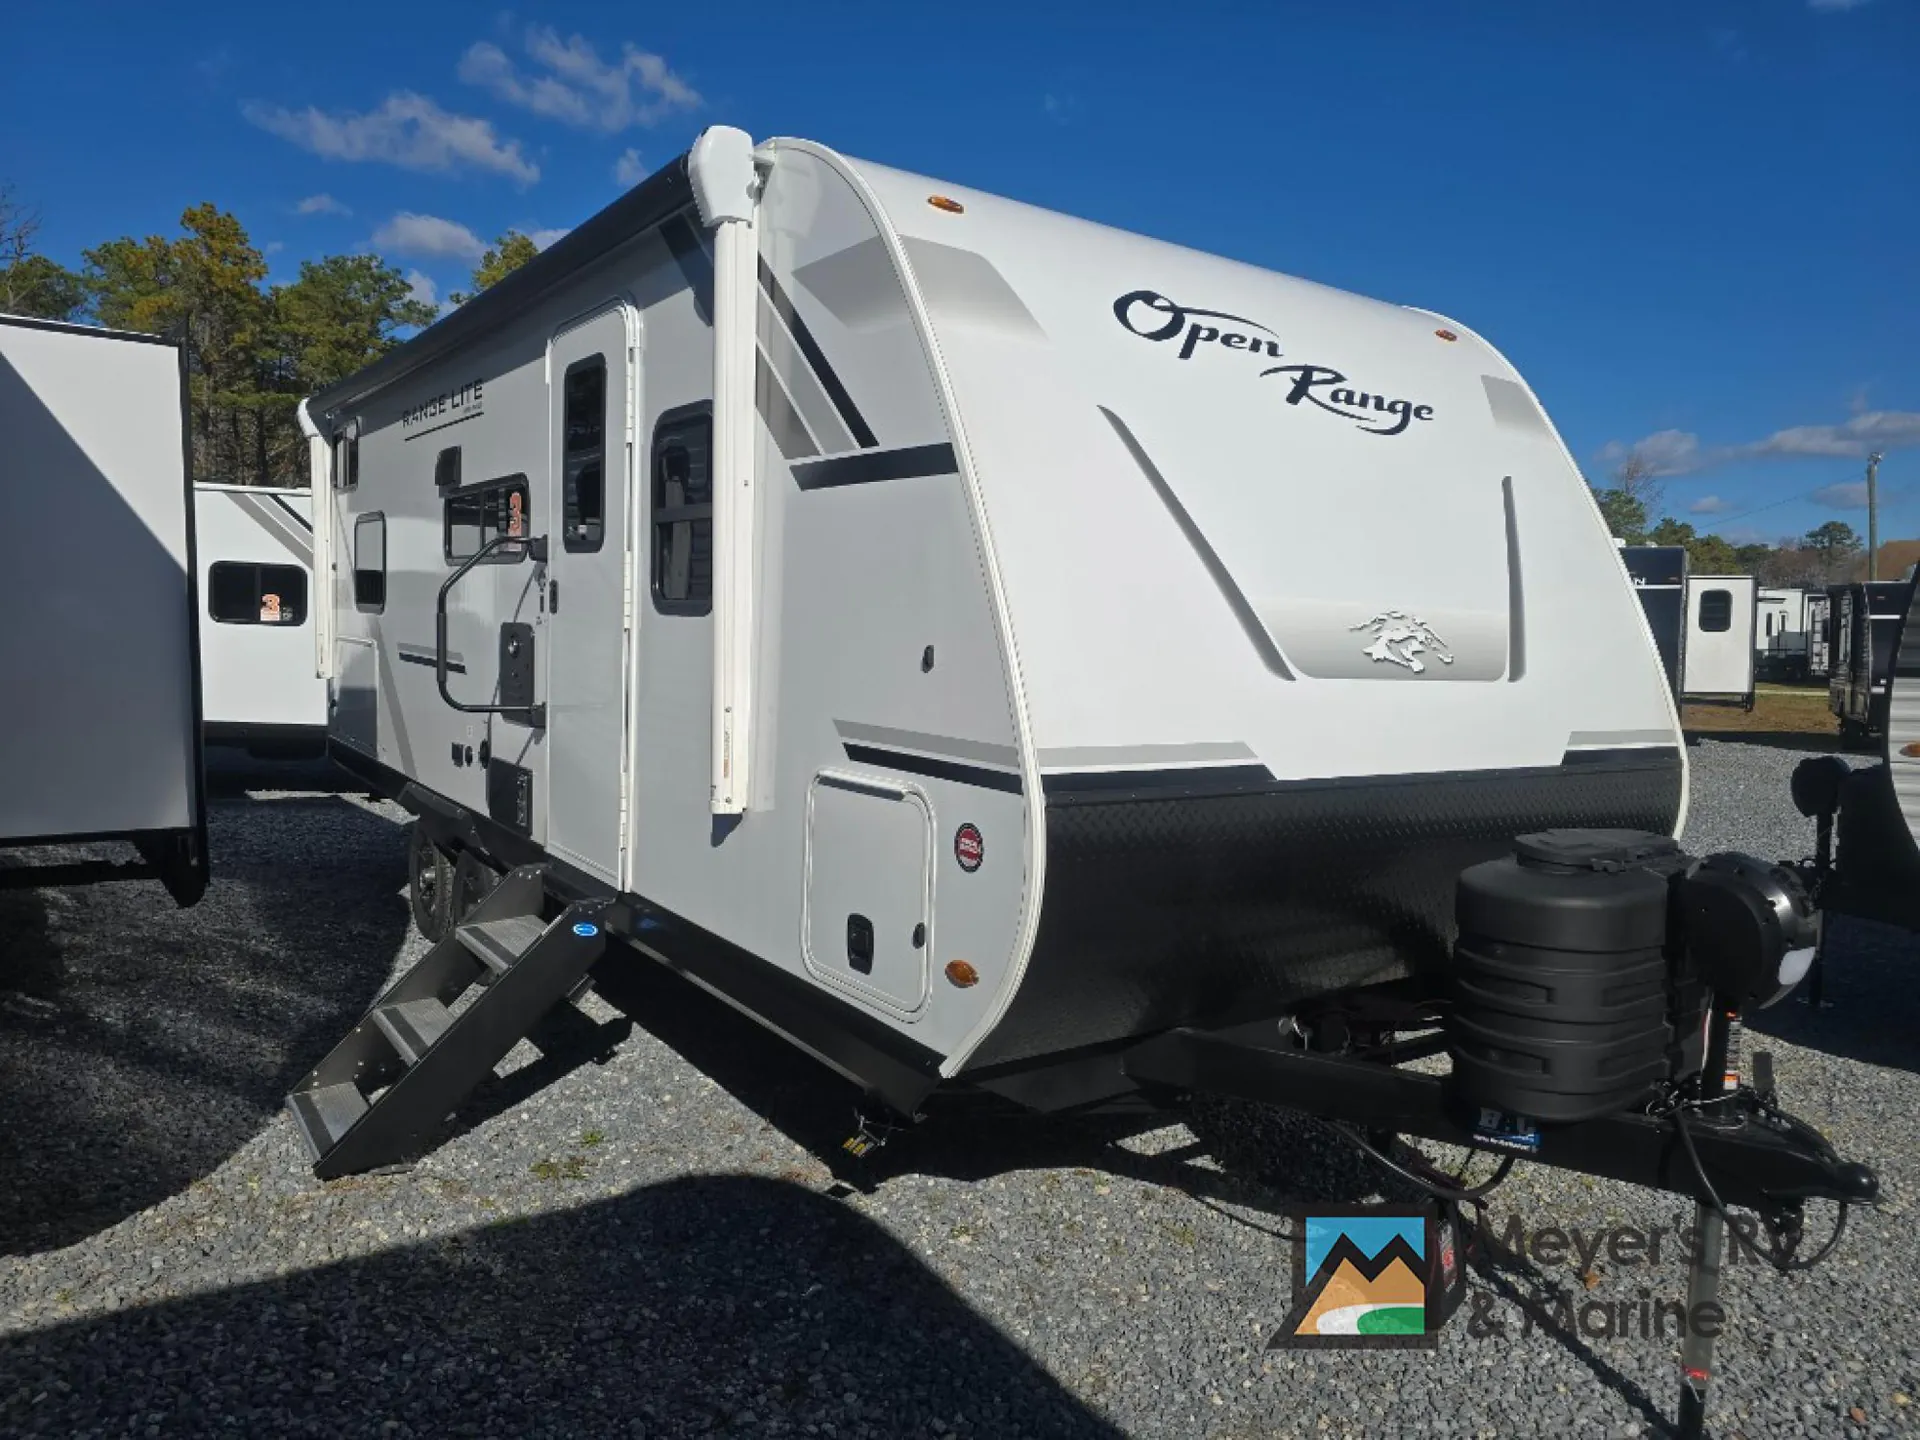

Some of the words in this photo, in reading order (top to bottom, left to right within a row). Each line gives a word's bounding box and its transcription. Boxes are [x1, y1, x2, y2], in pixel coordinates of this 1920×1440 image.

[1113, 290, 1283, 360] Open
[402, 393, 447, 428] RANGE
[451, 378, 483, 409] LITE
[1259, 364, 1433, 435] Range
